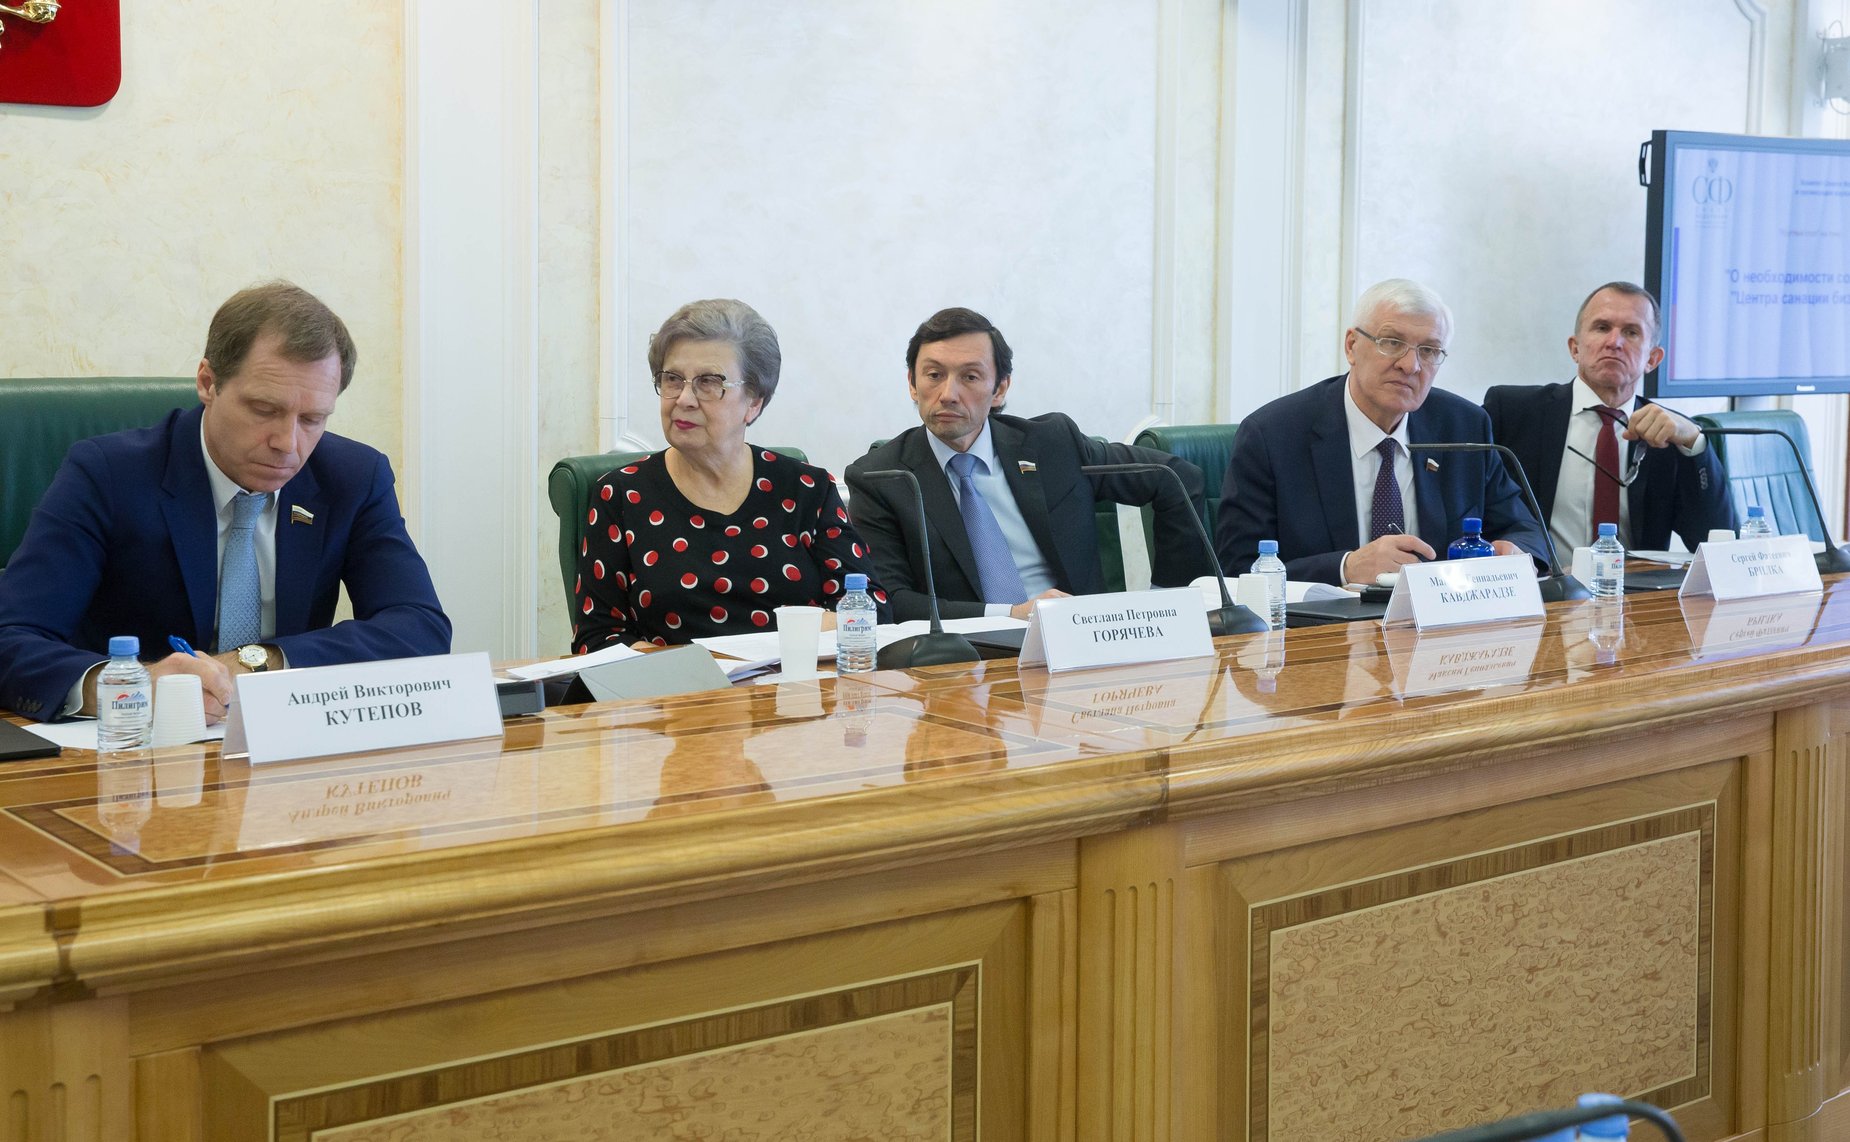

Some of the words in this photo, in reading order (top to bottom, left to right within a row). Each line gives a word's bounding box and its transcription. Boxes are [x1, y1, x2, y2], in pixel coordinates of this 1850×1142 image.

[1744, 269, 1834, 284] необходимости
[1782, 294, 1829, 307] санации
[1440, 586, 1517, 603] КАВДЖАРАДЗЕ
[1072, 613, 1124, 625] Светлана
[1126, 608, 1177, 621] Петровна
[1093, 625, 1164, 643] ГОРЯЧЕВА
[288, 686, 349, 706] Андрей
[354, 679, 451, 699] Викторович
[325, 701, 423, 726] КУТЕПОВ
